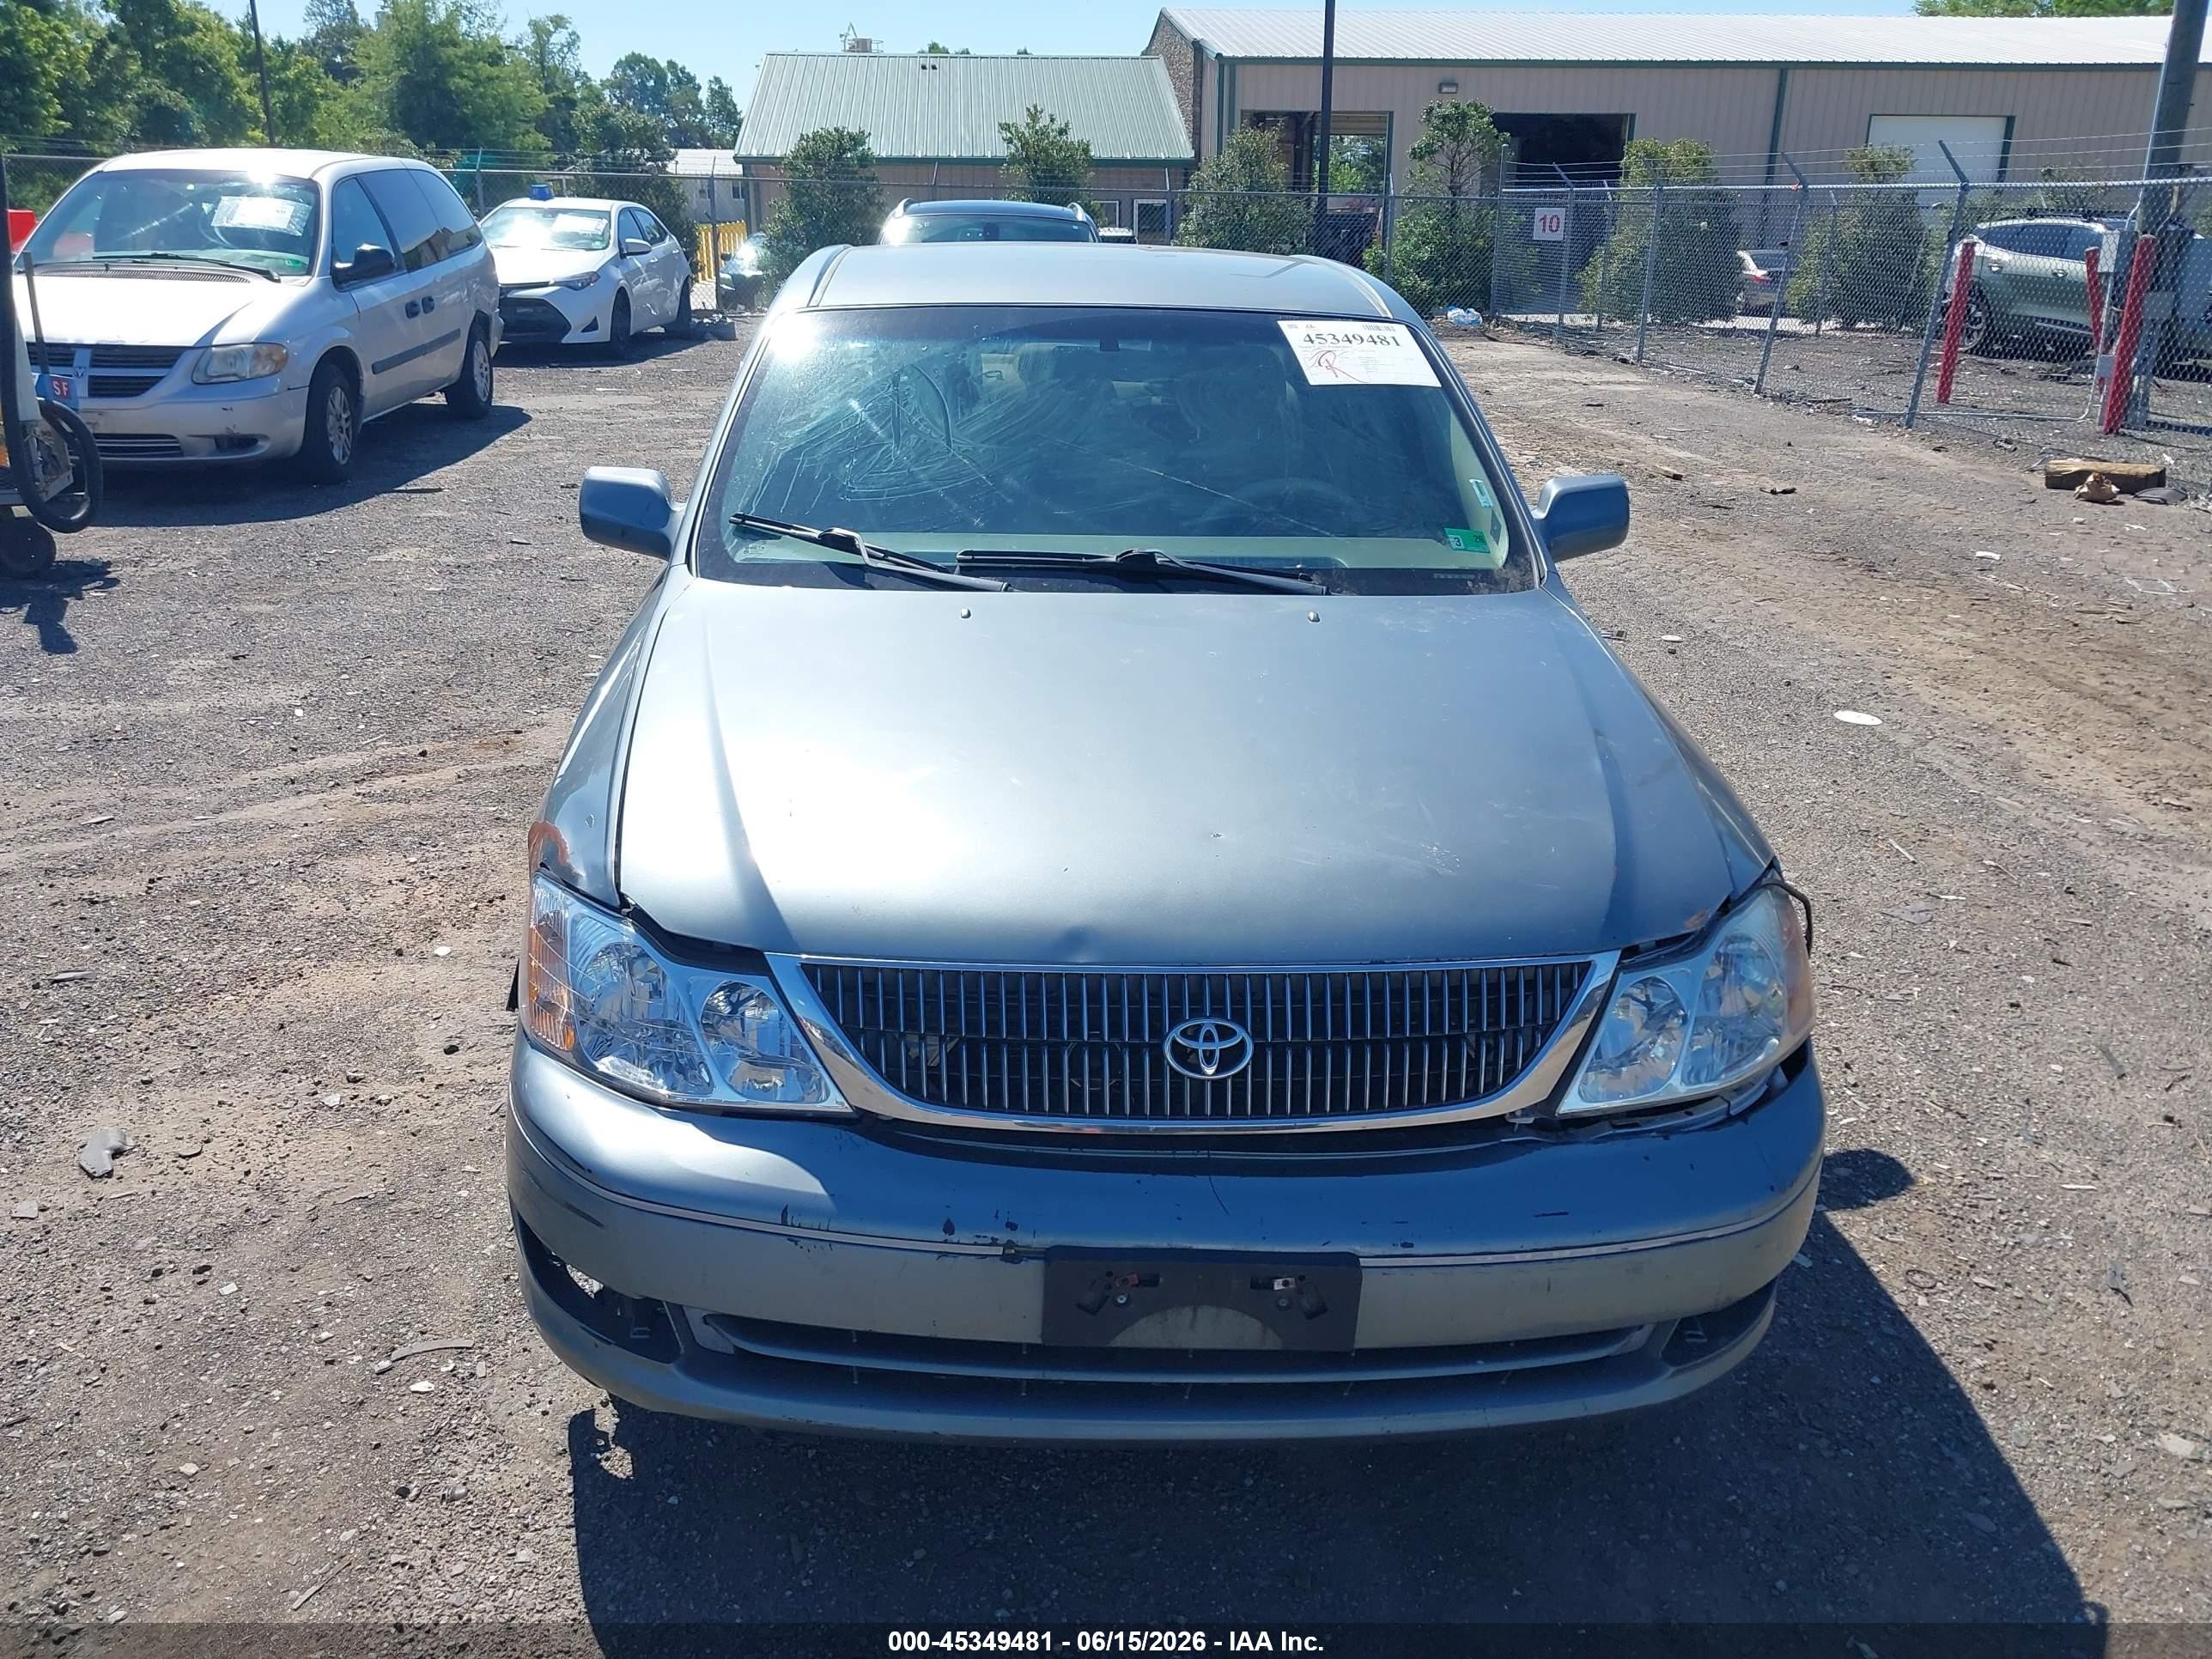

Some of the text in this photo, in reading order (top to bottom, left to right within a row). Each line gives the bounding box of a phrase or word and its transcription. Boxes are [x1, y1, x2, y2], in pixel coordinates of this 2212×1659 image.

[1539, 215, 1561, 234] 10
[1304, 332, 1401, 347] 45349481
[1454, 537, 1462, 547] 3
